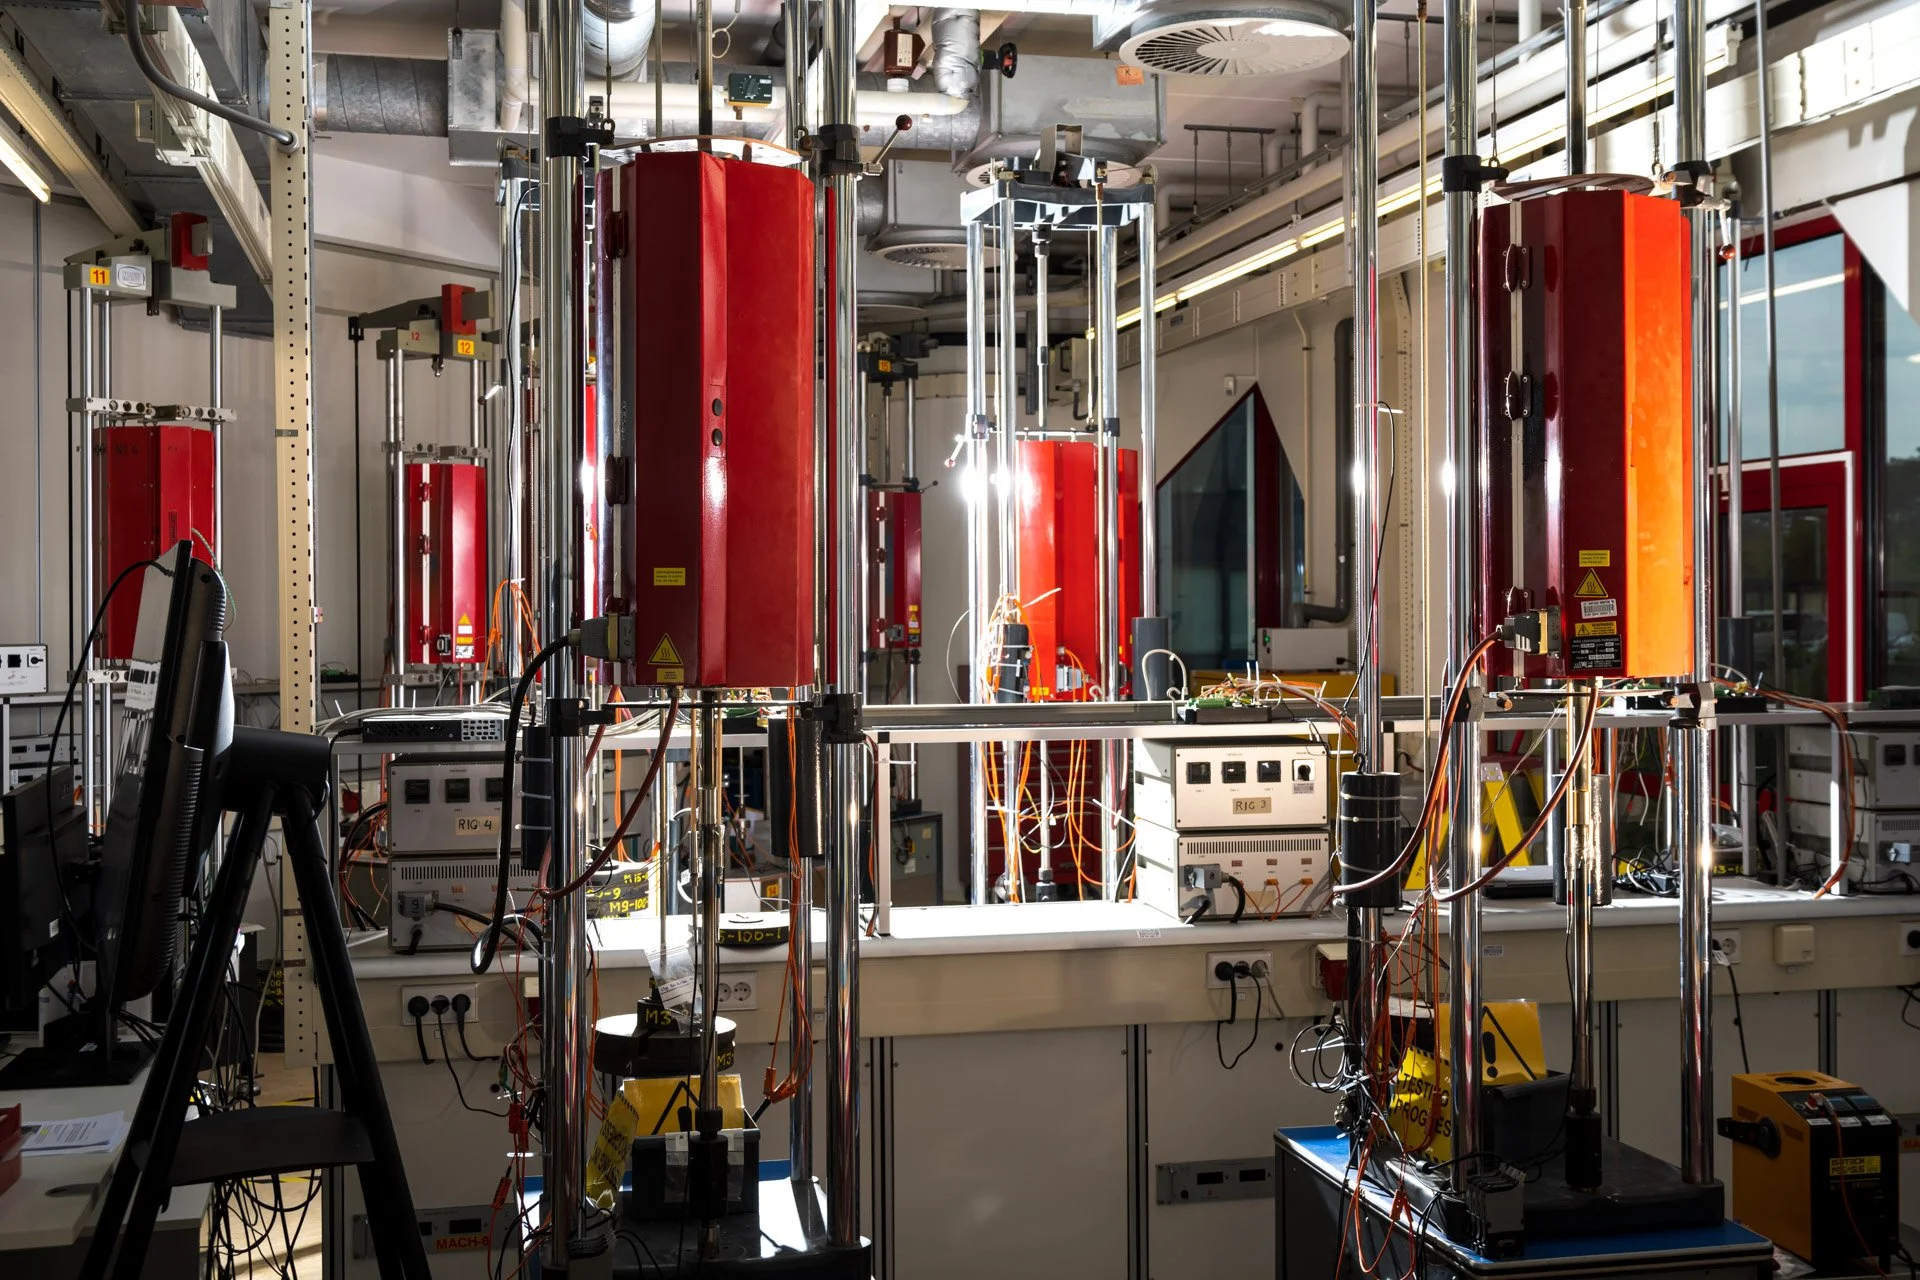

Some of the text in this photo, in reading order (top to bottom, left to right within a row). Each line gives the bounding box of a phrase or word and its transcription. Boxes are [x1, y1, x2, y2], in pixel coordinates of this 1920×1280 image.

[93, 269, 105, 284] 11
[411, 331, 420, 341] 12
[460, 341, 471, 354] 12
[1235, 799, 1267, 811] RIG 3
[458, 818, 492, 830] RIG 4
[1403, 1073, 1450, 1107] TESTIG
[436, 1235, 489, 1250] MACH-8
